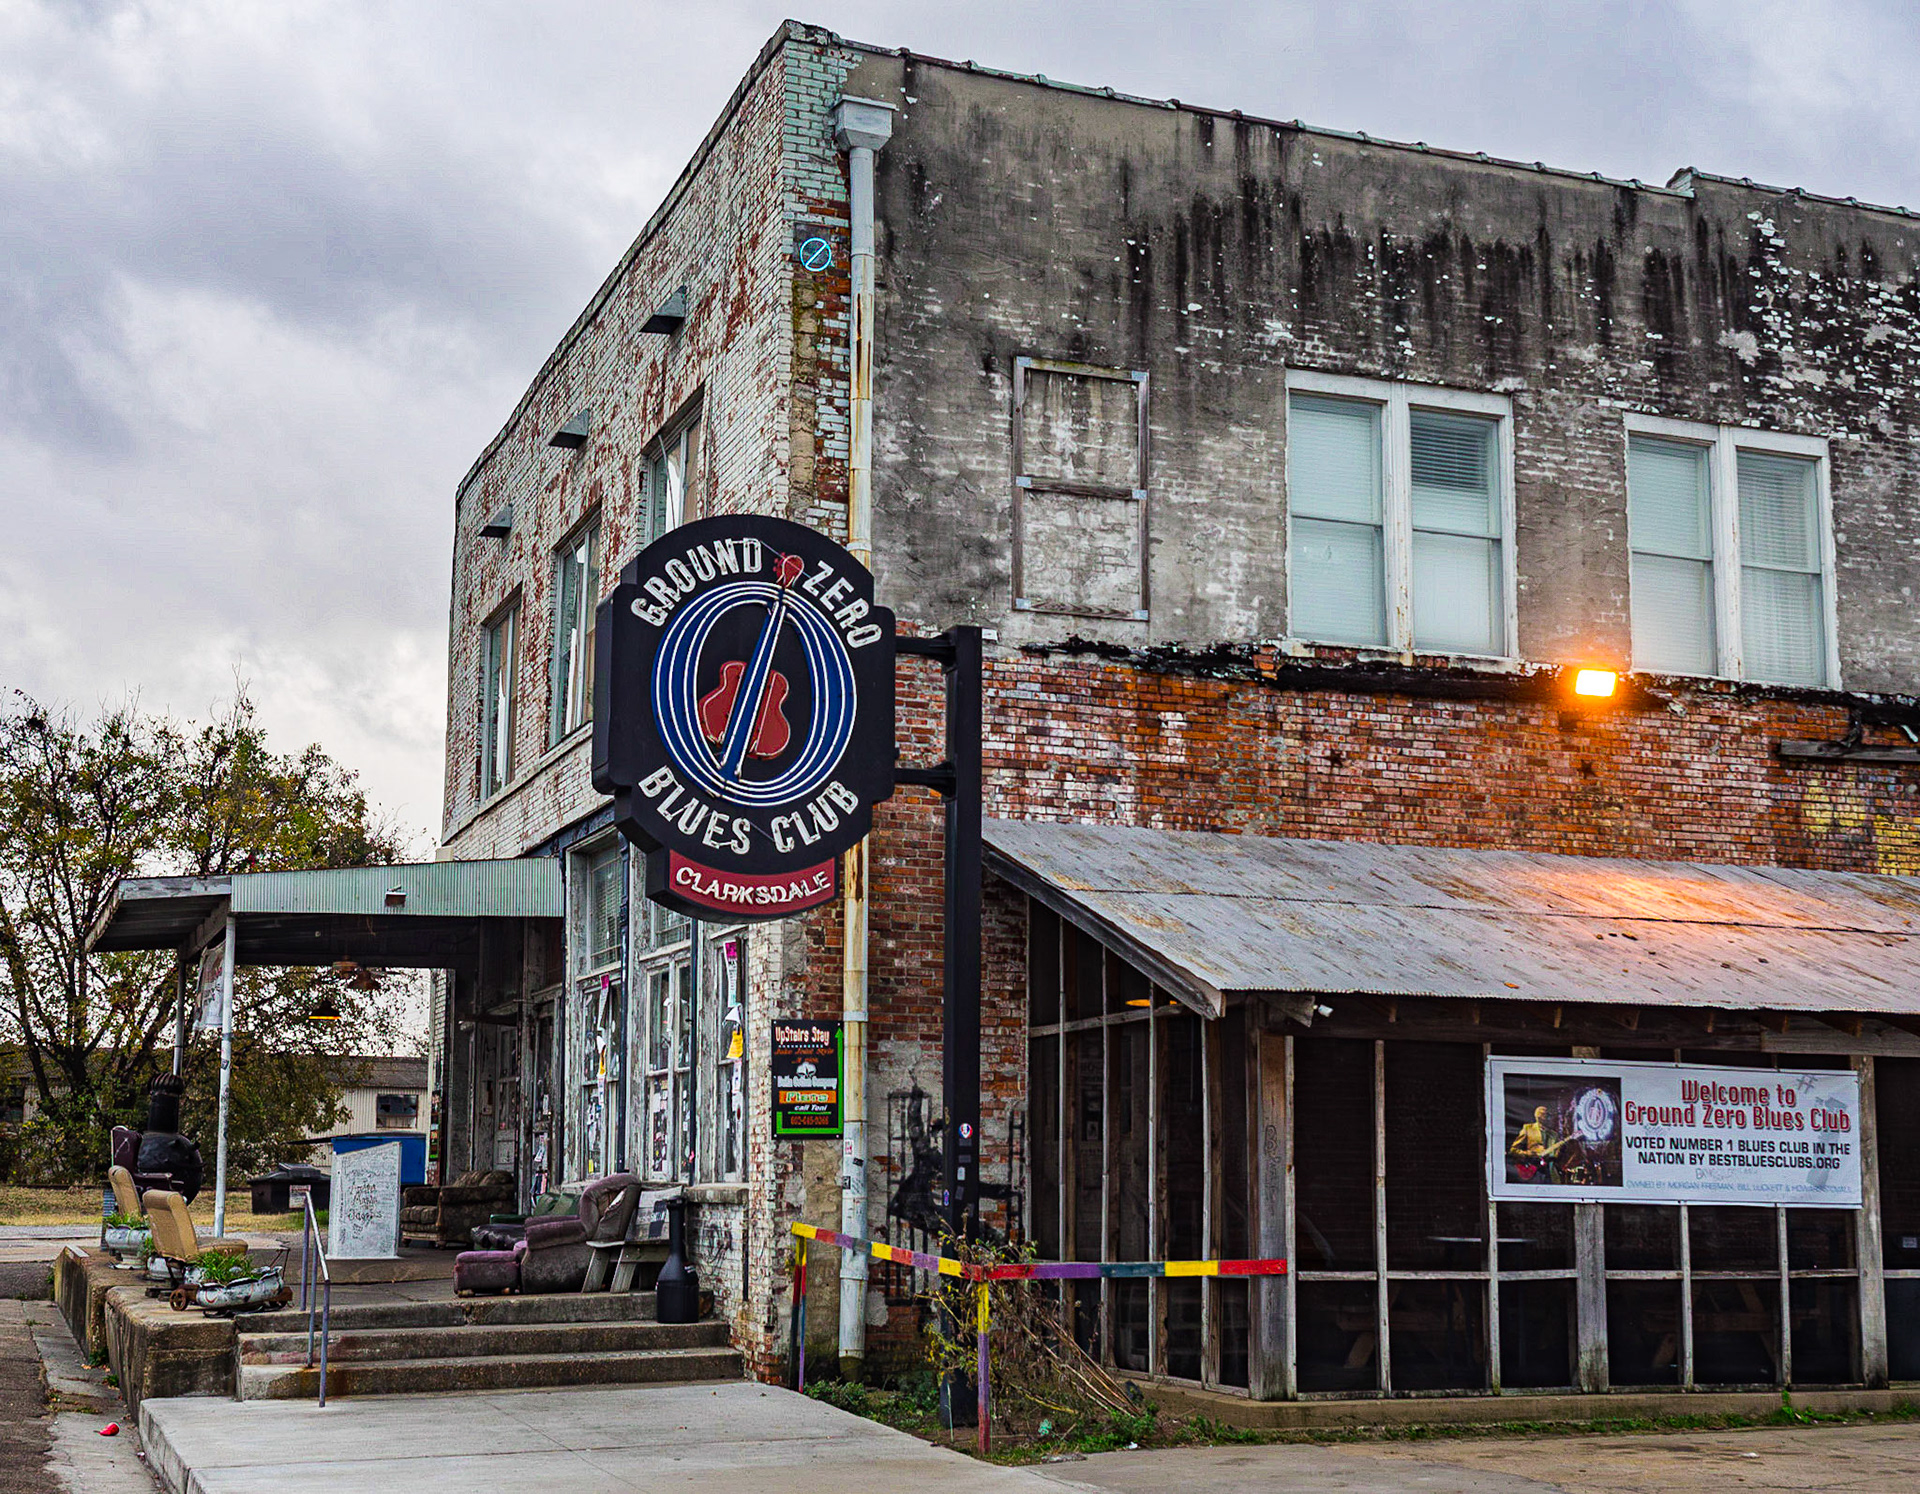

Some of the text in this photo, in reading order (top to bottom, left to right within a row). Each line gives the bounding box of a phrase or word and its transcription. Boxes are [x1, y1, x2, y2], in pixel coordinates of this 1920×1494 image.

[631, 538, 883, 649] GROUND ZERO
[638, 765, 859, 854] BLUES CLUB
[676, 866, 831, 905] CLARKSDALE
[811, 1026, 830, 1046] Stay
[1682, 1080, 1796, 1107] Welcome to
[1625, 1101, 1851, 1133] Ground Zero Blues Club
[1625, 1136, 1851, 1155] VOTED NUMBER 1 BLUES CLUB IN THE
[1638, 1152, 1840, 1169] NATION BY BESTBLUESCLUBS.ORG
[1626, 1180, 1655, 1189] OWNED
[1656, 1181, 1666, 1189] BY
[1668, 1181, 1699, 1190] MORGAN
